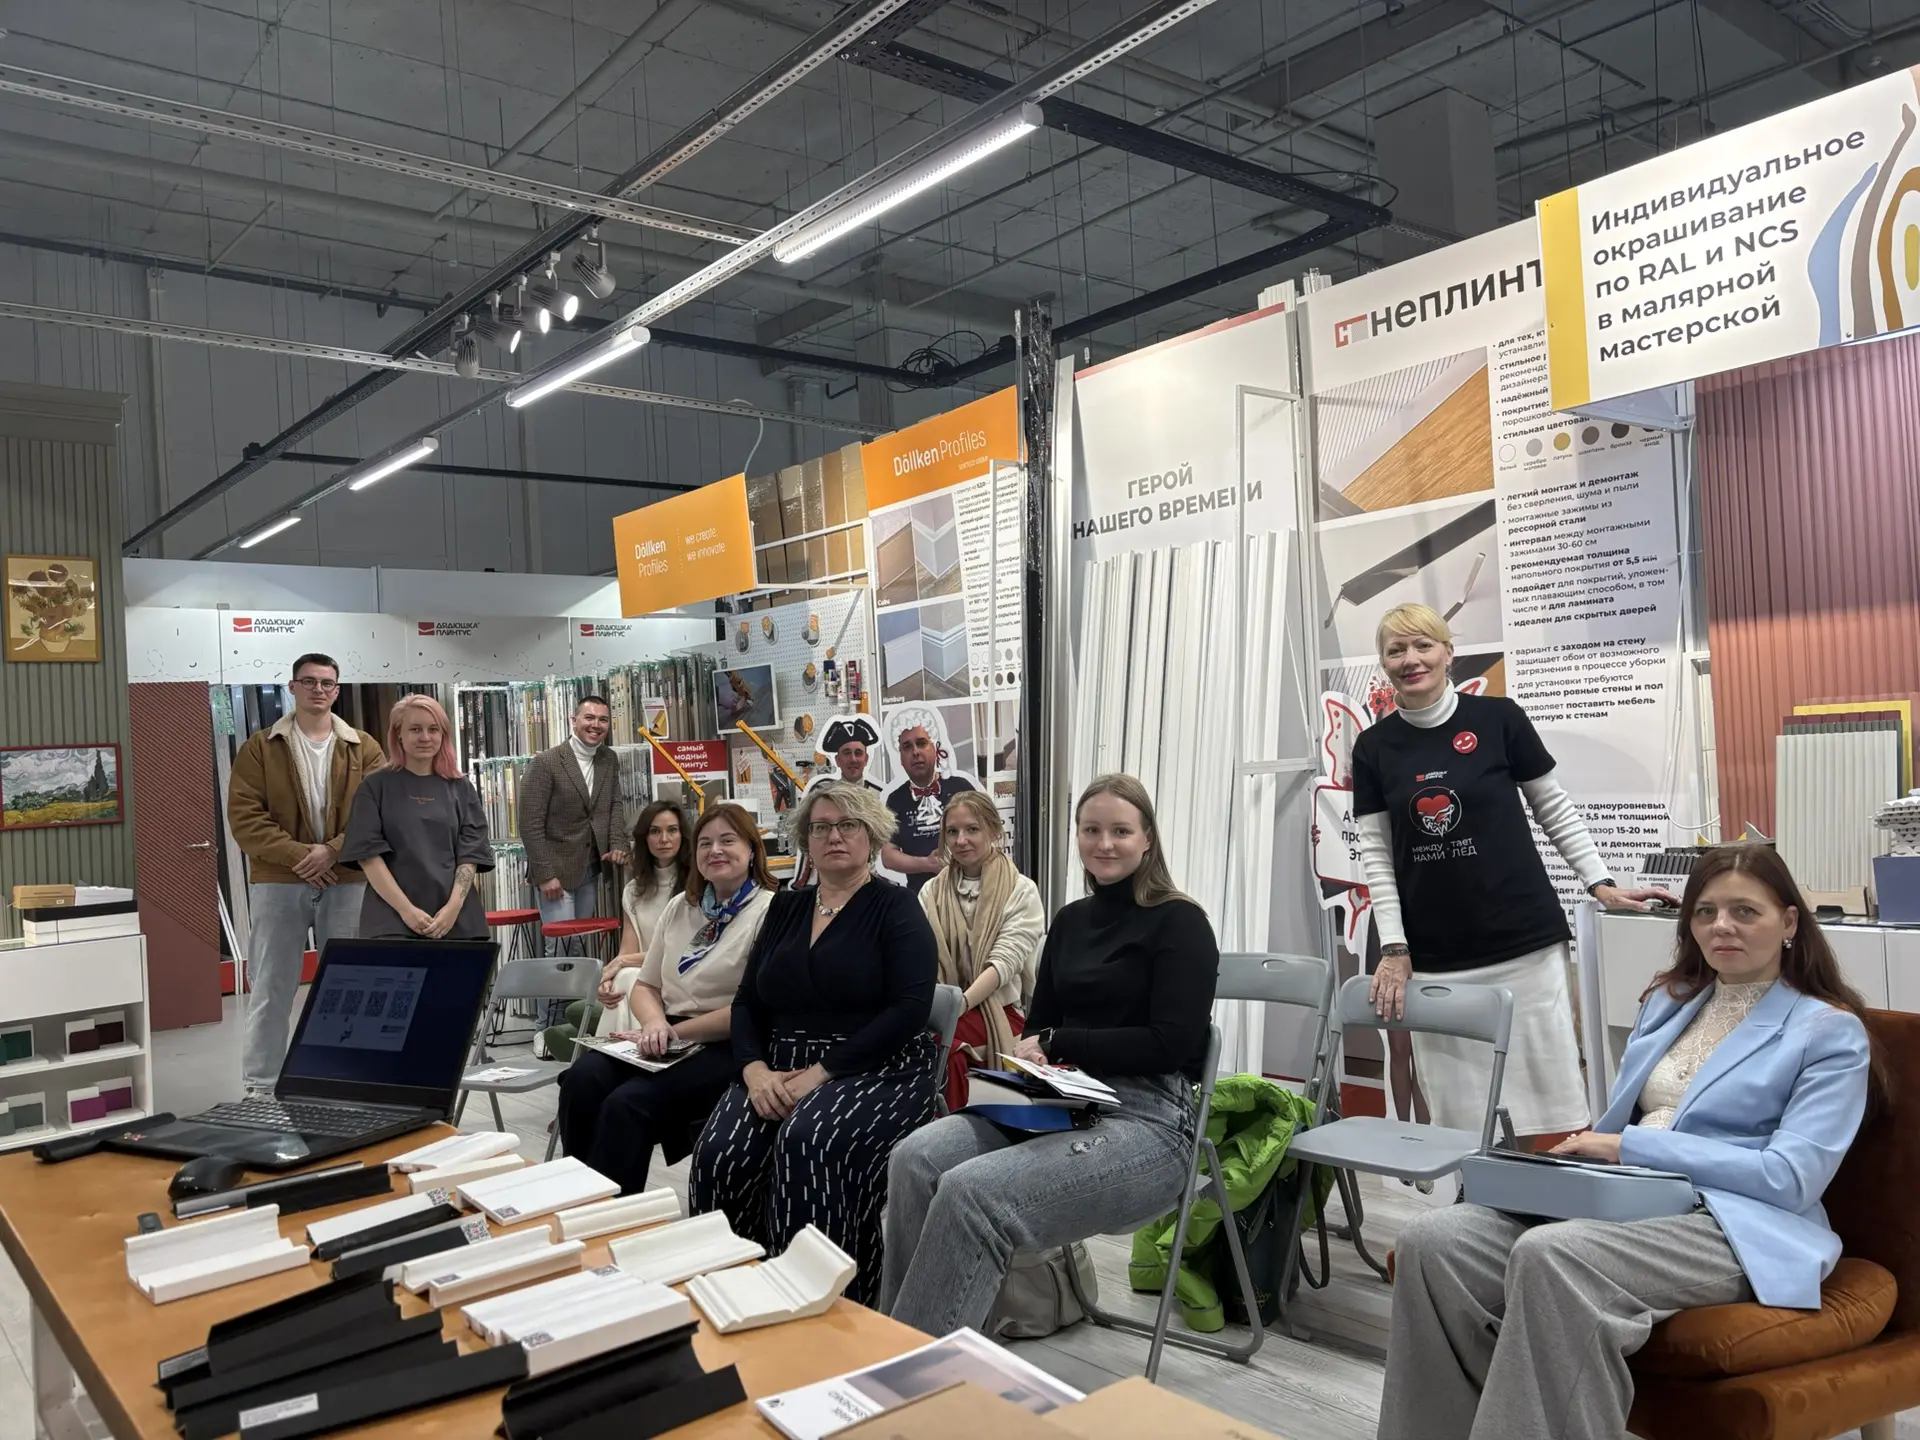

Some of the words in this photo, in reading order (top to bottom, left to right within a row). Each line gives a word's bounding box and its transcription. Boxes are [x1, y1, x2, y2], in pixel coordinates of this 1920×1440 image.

[1592, 131, 1864, 234] Индивидуальное
[1593, 186, 1806, 265] окрашивание
[1596, 276, 1629, 298] по
[1640, 253, 1696, 285] RAL
[1707, 247, 1723, 265] и
[1736, 220, 1798, 253] NCS
[1598, 314, 1612, 330] в
[1622, 262, 1775, 323] малярной
[1601, 298, 1780, 362] мастерской
[1498, 339, 1515, 348] для
[1517, 332, 1534, 341] тех,
[1500, 355, 1541, 370] стильное
[1502, 401, 1549, 416] покрытие:
[1503, 425, 1545, 439] стильная
[1128, 462, 1193, 499] ГЕРОЙ
[1507, 488, 1538, 502] легкий
[1541, 482, 1577, 495] монтаж
[1589, 470, 1639, 488] демонтаж
[1507, 502, 1522, 512] без
[1524, 494, 1574, 509] сверления,
[1577, 488, 1602, 501] шума
[1613, 482, 1639, 493] пыли
[1073, 506, 1153, 540] НАШЕГО
[1508, 510, 1559, 525] монтажные
[1562, 503, 1599, 516] зажимы
[1508, 520, 1556, 535] рессорной
[1559, 516, 1586, 527] стали
[1509, 535, 1552, 548] интервал
[1554, 530, 1584, 542] между
[1587, 519, 1651, 535] монтажными
[635, 540, 666, 559] Döllken
[685, 535, 695, 545] we
[1510, 544, 1556, 558] зажимами
[1558, 540, 1583, 551] 30-60
[687, 550, 696, 560] we
[1511, 555, 1584, 572] рекомендуемая
[1587, 547, 1630, 560] толщина
[638, 559, 668, 578] Profiles
[1511, 567, 1562, 581] напольного
[1565, 561, 1610, 575] покрытия
[1613, 559, 1623, 567] от
[1512, 581, 1556, 594] подойдет
[1558, 579, 1574, 588] для
[1576, 572, 1626, 586] покрытий,
[1513, 596, 1529, 604] ных
[1532, 588, 1585, 603] плавающим
[1588, 582, 1636, 595] способом,
[1647, 579, 1665, 587] том
[1513, 605, 1538, 614] числе
[1549, 602, 1565, 611] для
[1568, 596, 1614, 608] ламината
[1514, 615, 1552, 627] идеален
[1554, 614, 1572, 623] для
[1574, 609, 1617, 621] скрытых
[1620, 604, 1657, 617] дверей
[1516, 646, 1551, 656] вариант
[1561, 641, 1601, 652] заходом
[1618, 637, 1646, 648] стену
[1516, 656, 1560, 666] защищает
[1563, 653, 1584, 662] обои
[1600, 647, 1659, 659] возможного
[1516, 665, 1572, 677] загрязнения
[1582, 660, 1627, 672] процессе
[1629, 658, 1666, 668] уборки
[1517, 681, 1533, 689] для
[1535, 677, 1581, 689] установки
[1584, 674, 1633, 684] требуются
[1518, 688, 1561, 700] идеально
[1564, 687, 1600, 697] ровные
[1602, 685, 1632, 693] стены
[1566, 698, 1615, 710] поставить
[1618, 697, 1656, 706] мебель
[1574, 711, 1608, 719] стенам
[674, 752, 708, 761] модный
[677, 744, 704, 752] самый
[1586, 813, 1599, 821] 5,5
[1412, 843, 1443, 853] между
[1451, 838, 1472, 847] тает
[1414, 851, 1445, 862] НАМИ
